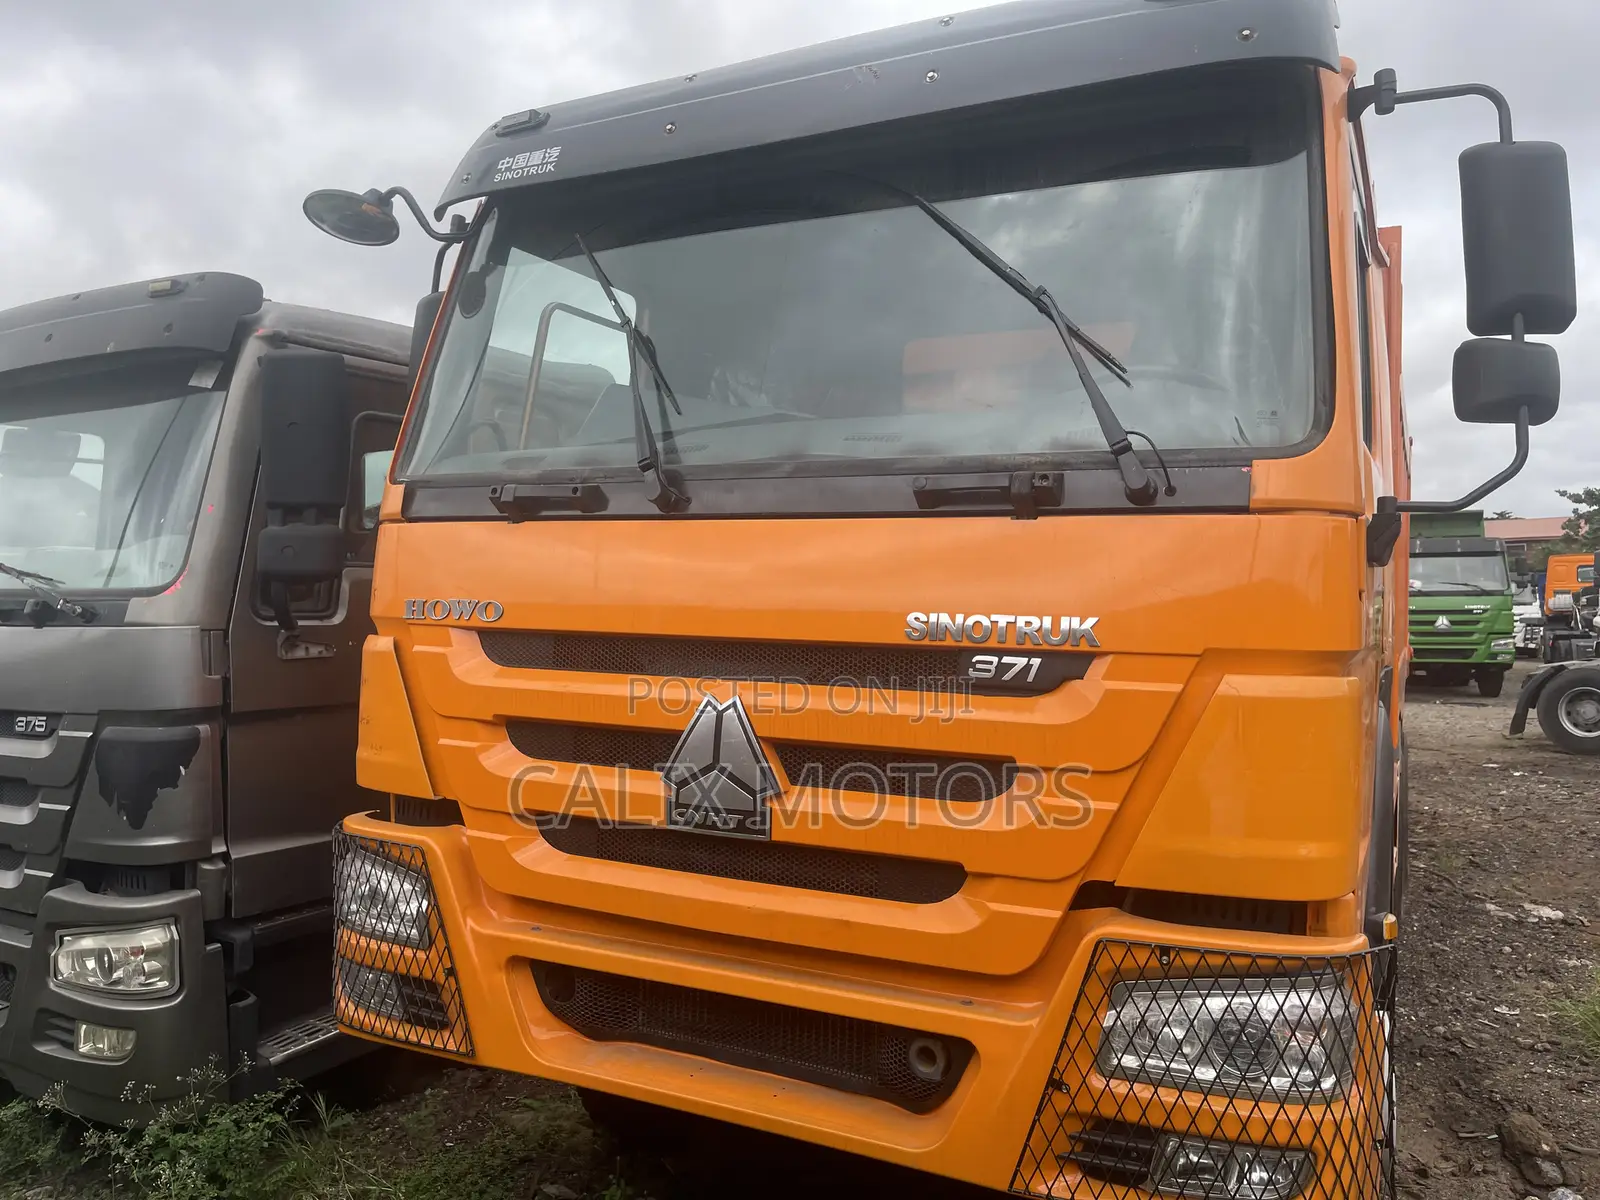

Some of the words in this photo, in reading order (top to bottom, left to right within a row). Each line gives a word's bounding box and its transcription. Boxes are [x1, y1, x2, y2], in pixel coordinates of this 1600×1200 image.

[497, 146, 561, 171] 中国重汽
[493, 162, 556, 182] SINOTRUK
[403, 598, 504, 622] HOWO
[904, 612, 1101, 647] SINOTRUK
[968, 655, 1042, 683] 371
[15, 716, 47, 732] 375
